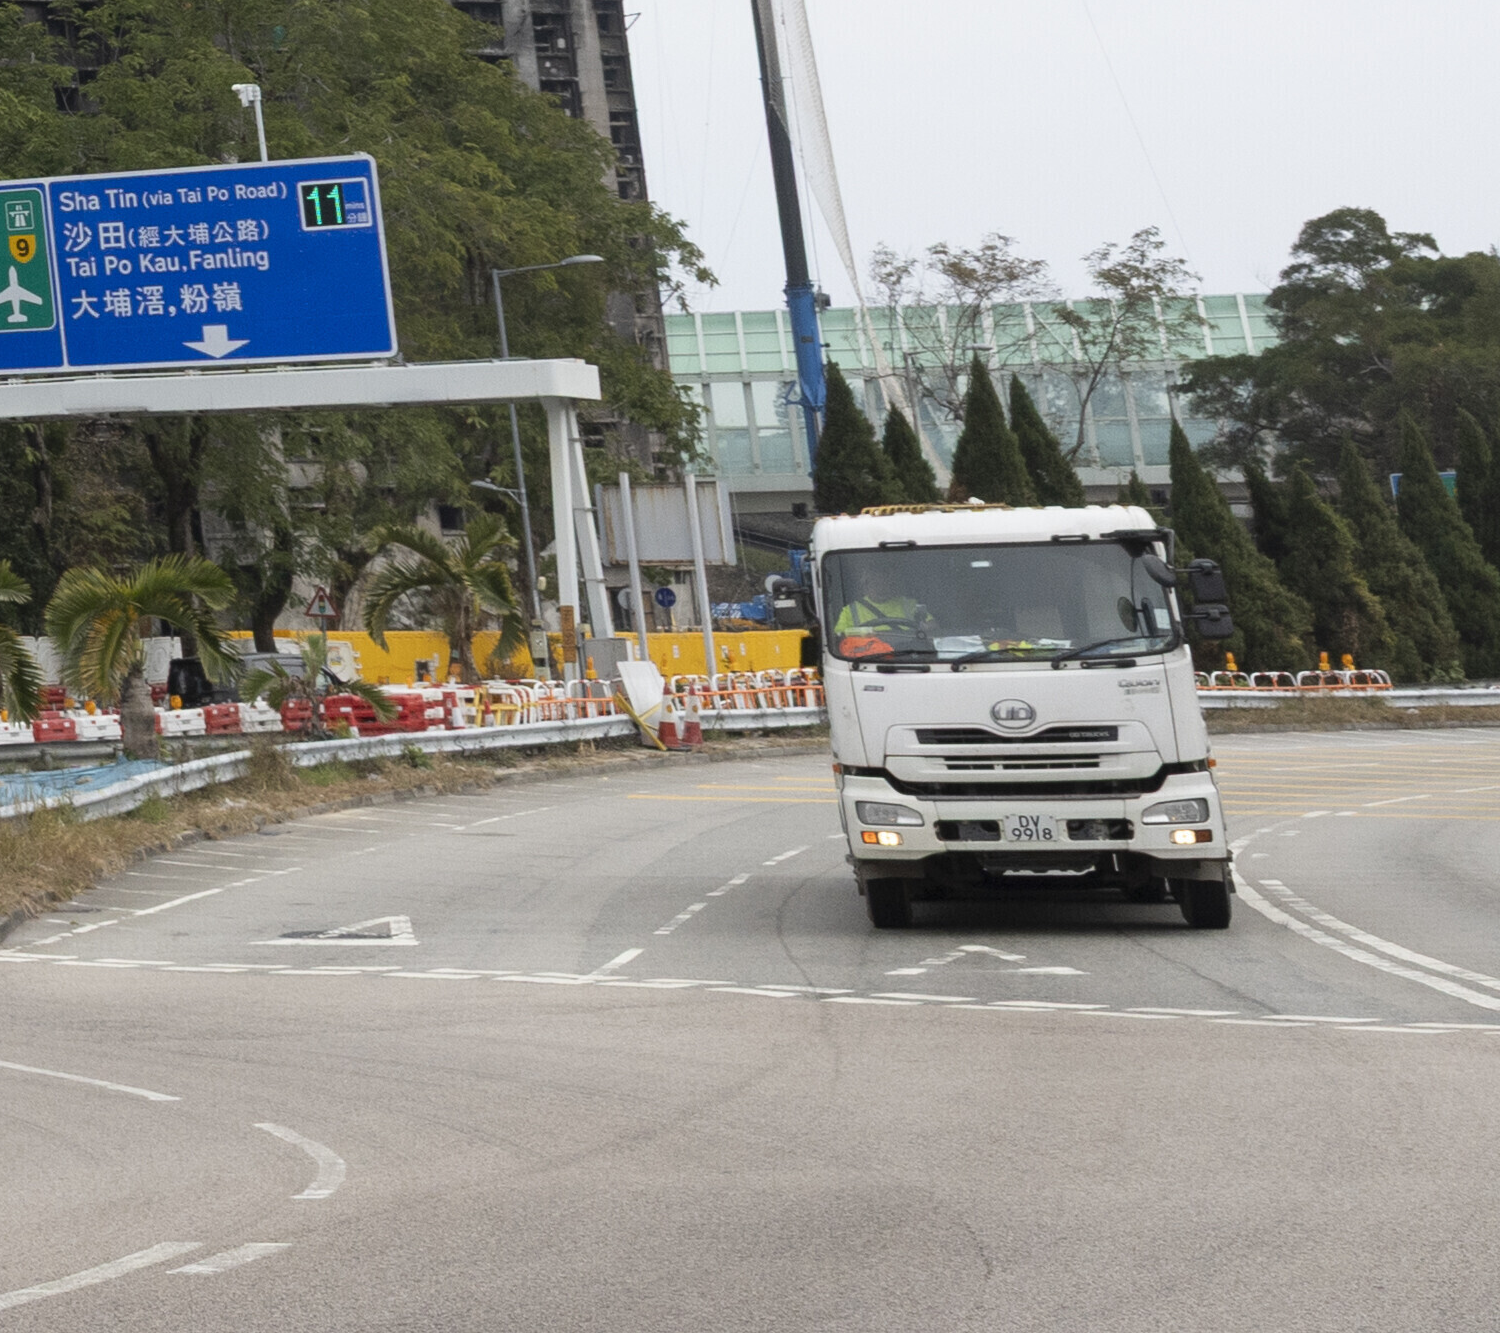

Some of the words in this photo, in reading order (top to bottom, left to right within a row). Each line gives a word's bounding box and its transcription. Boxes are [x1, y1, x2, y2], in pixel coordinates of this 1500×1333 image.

[59, 191, 100, 213] Sha
[105, 188, 138, 209] Tin
[142, 191, 173, 209] (via
[177, 187, 201, 204] Tai
[207, 186, 229, 202] Po
[235, 182, 287, 200] Road)
[306, 184, 342, 225] 11
[16, 238, 29, 257] 9
[66, 256, 97, 277] Tai
[104, 255, 132, 275] Po
[1012, 828, 1053, 841] 9918
